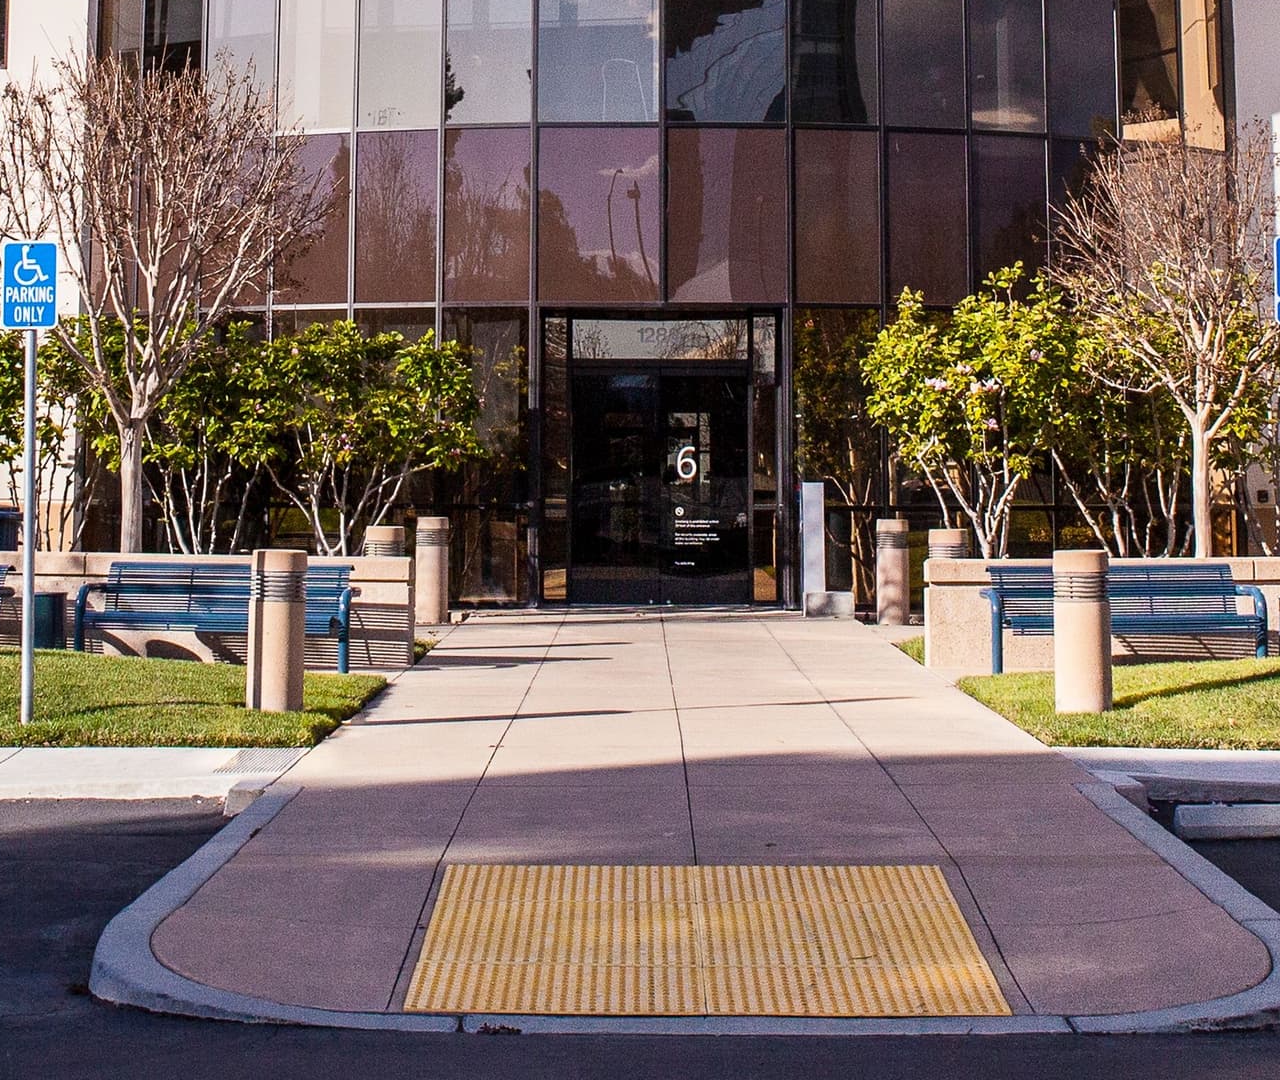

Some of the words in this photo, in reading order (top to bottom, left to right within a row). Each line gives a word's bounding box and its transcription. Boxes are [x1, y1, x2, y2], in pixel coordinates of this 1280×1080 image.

[6, 286, 54, 303] PARKING
[14, 306, 45, 323] ONLY
[676, 446, 698, 480] 6
